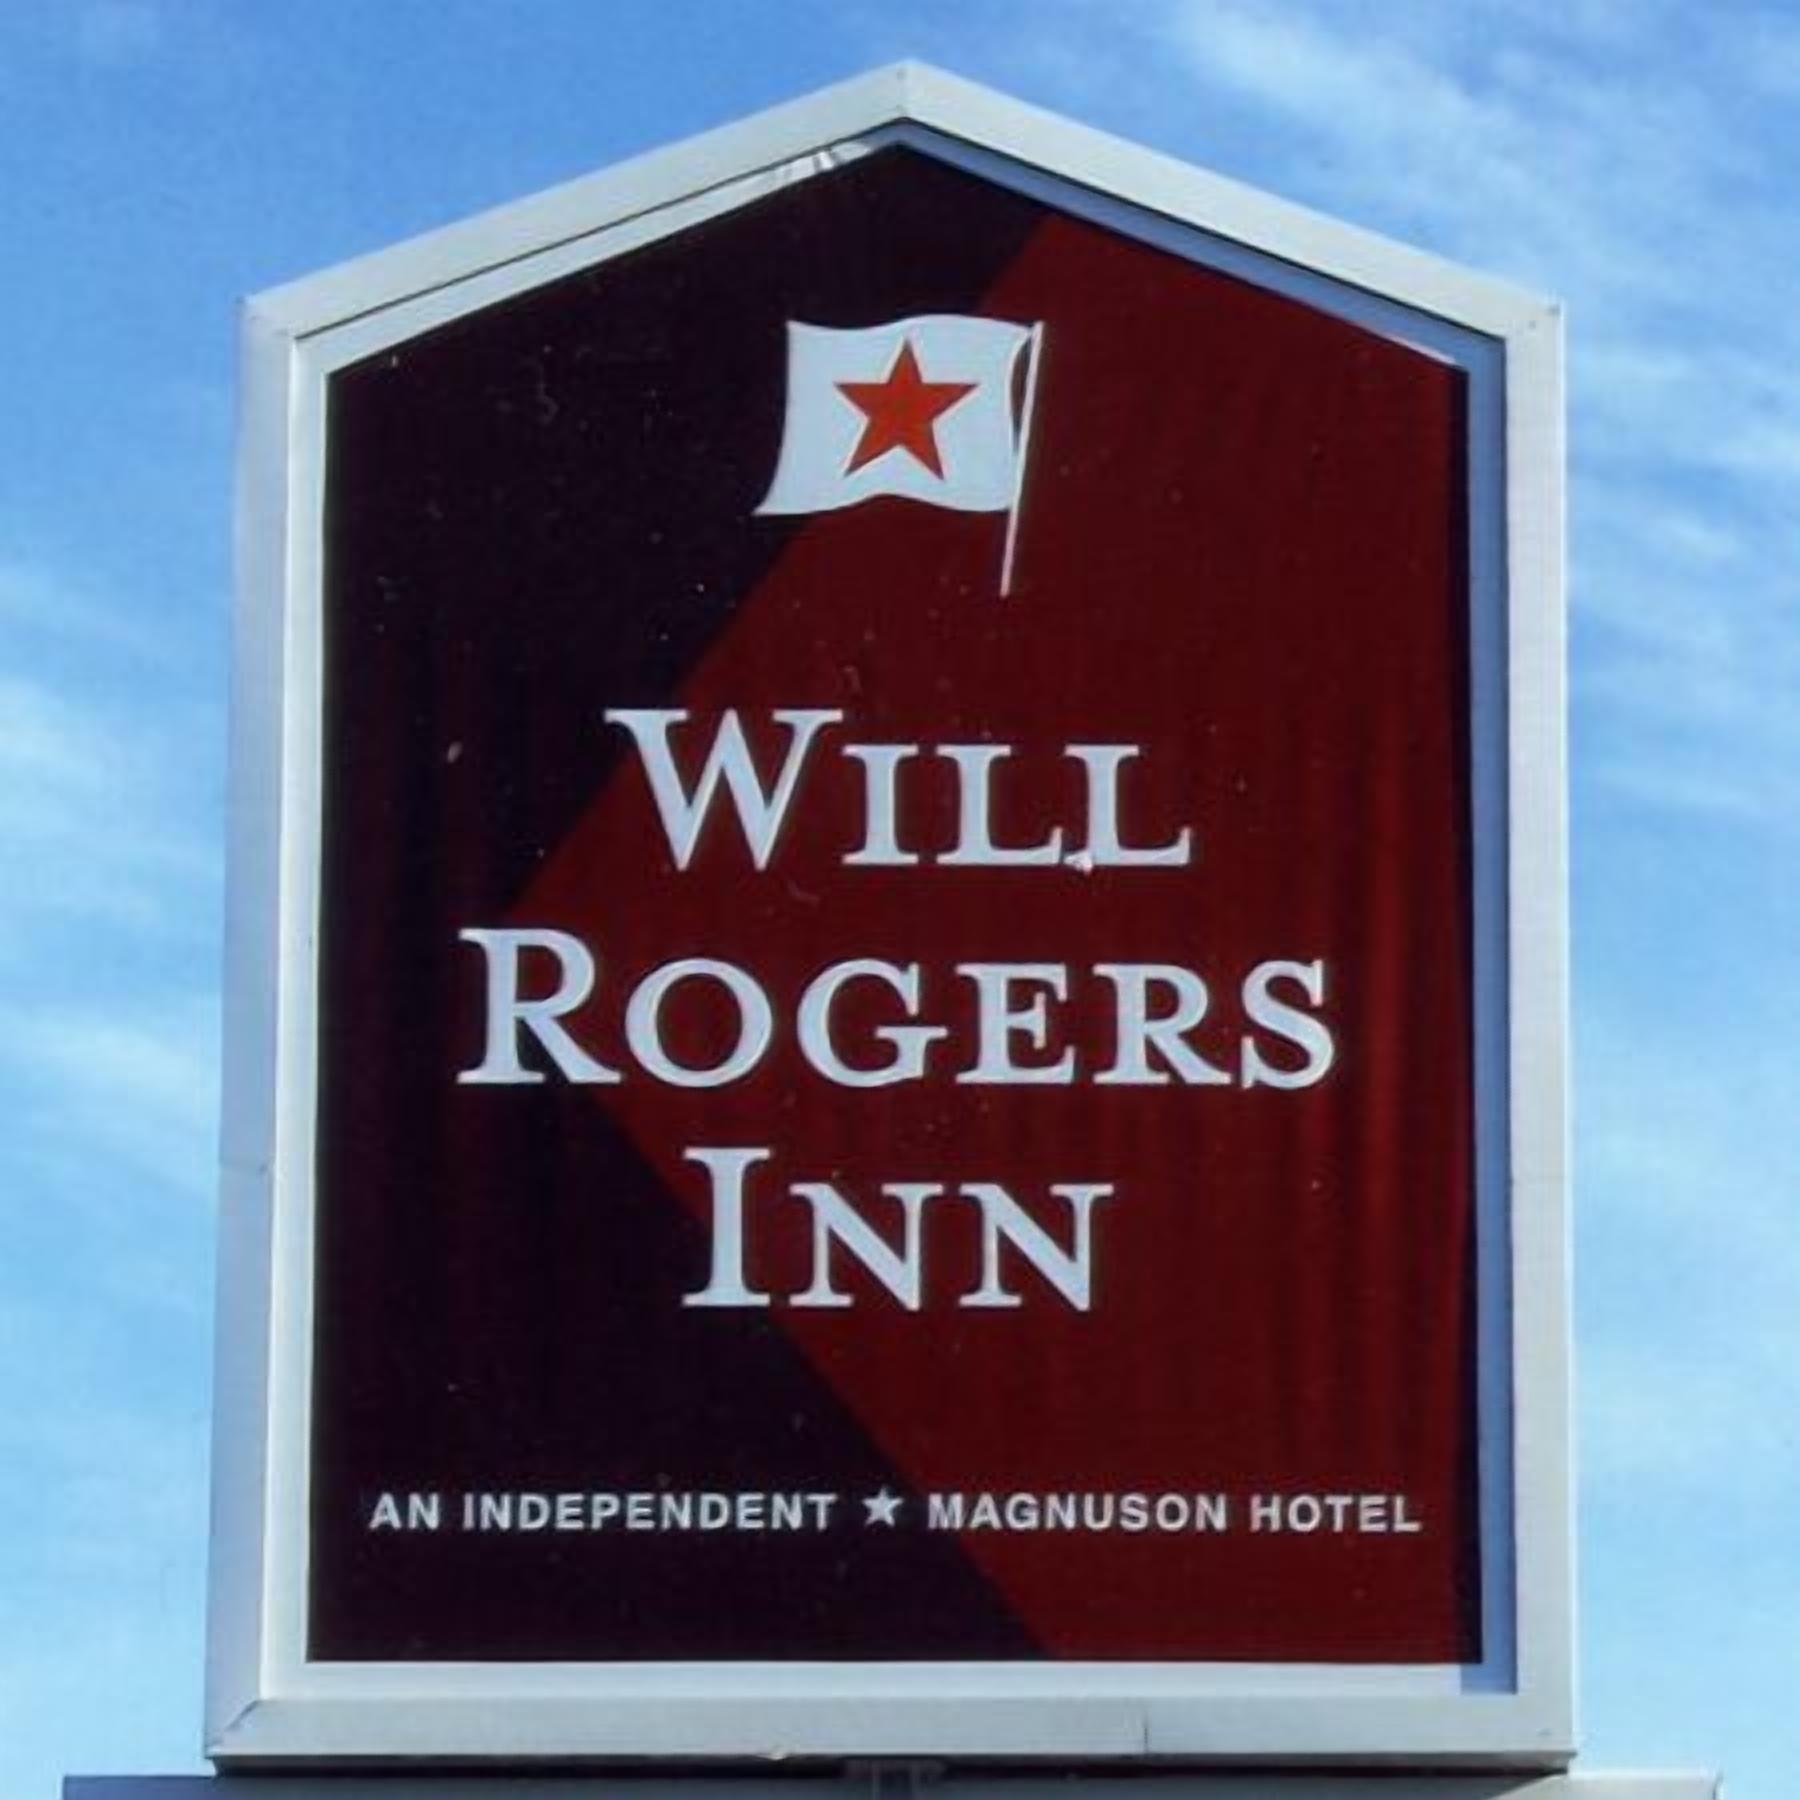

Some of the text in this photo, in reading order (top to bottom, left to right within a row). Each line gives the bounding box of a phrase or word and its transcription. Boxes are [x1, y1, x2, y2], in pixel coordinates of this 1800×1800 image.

[605, 708, 1192, 873] WILL
[457, 928, 1336, 1089] ROGERS
[682, 1147, 1115, 1311] INN
[370, 1493, 1421, 1533] AN INDEPENDENT MAGNUSON HOTEL
